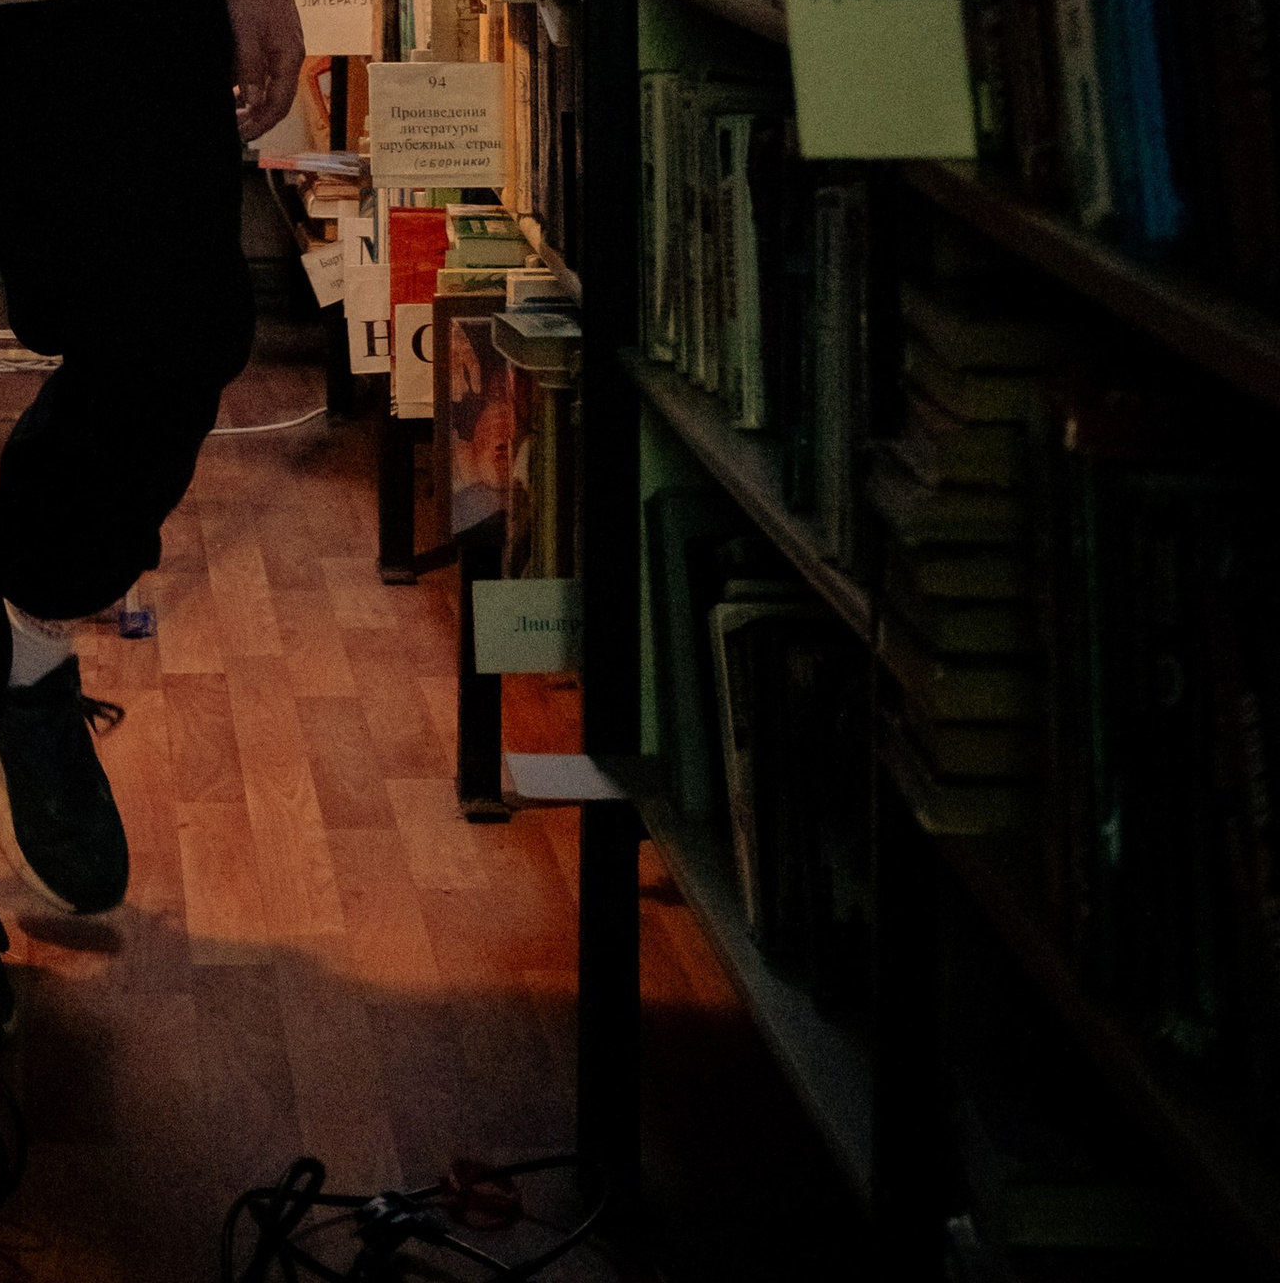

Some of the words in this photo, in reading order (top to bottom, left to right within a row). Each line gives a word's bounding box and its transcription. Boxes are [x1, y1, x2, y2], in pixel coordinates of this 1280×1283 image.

[428, 76, 446, 89] 94
[390, 106, 487, 120] Произведения
[400, 125, 478, 137] литературы
[377, 139, 455, 153] зарубежных
[466, 140, 501, 153] стран
